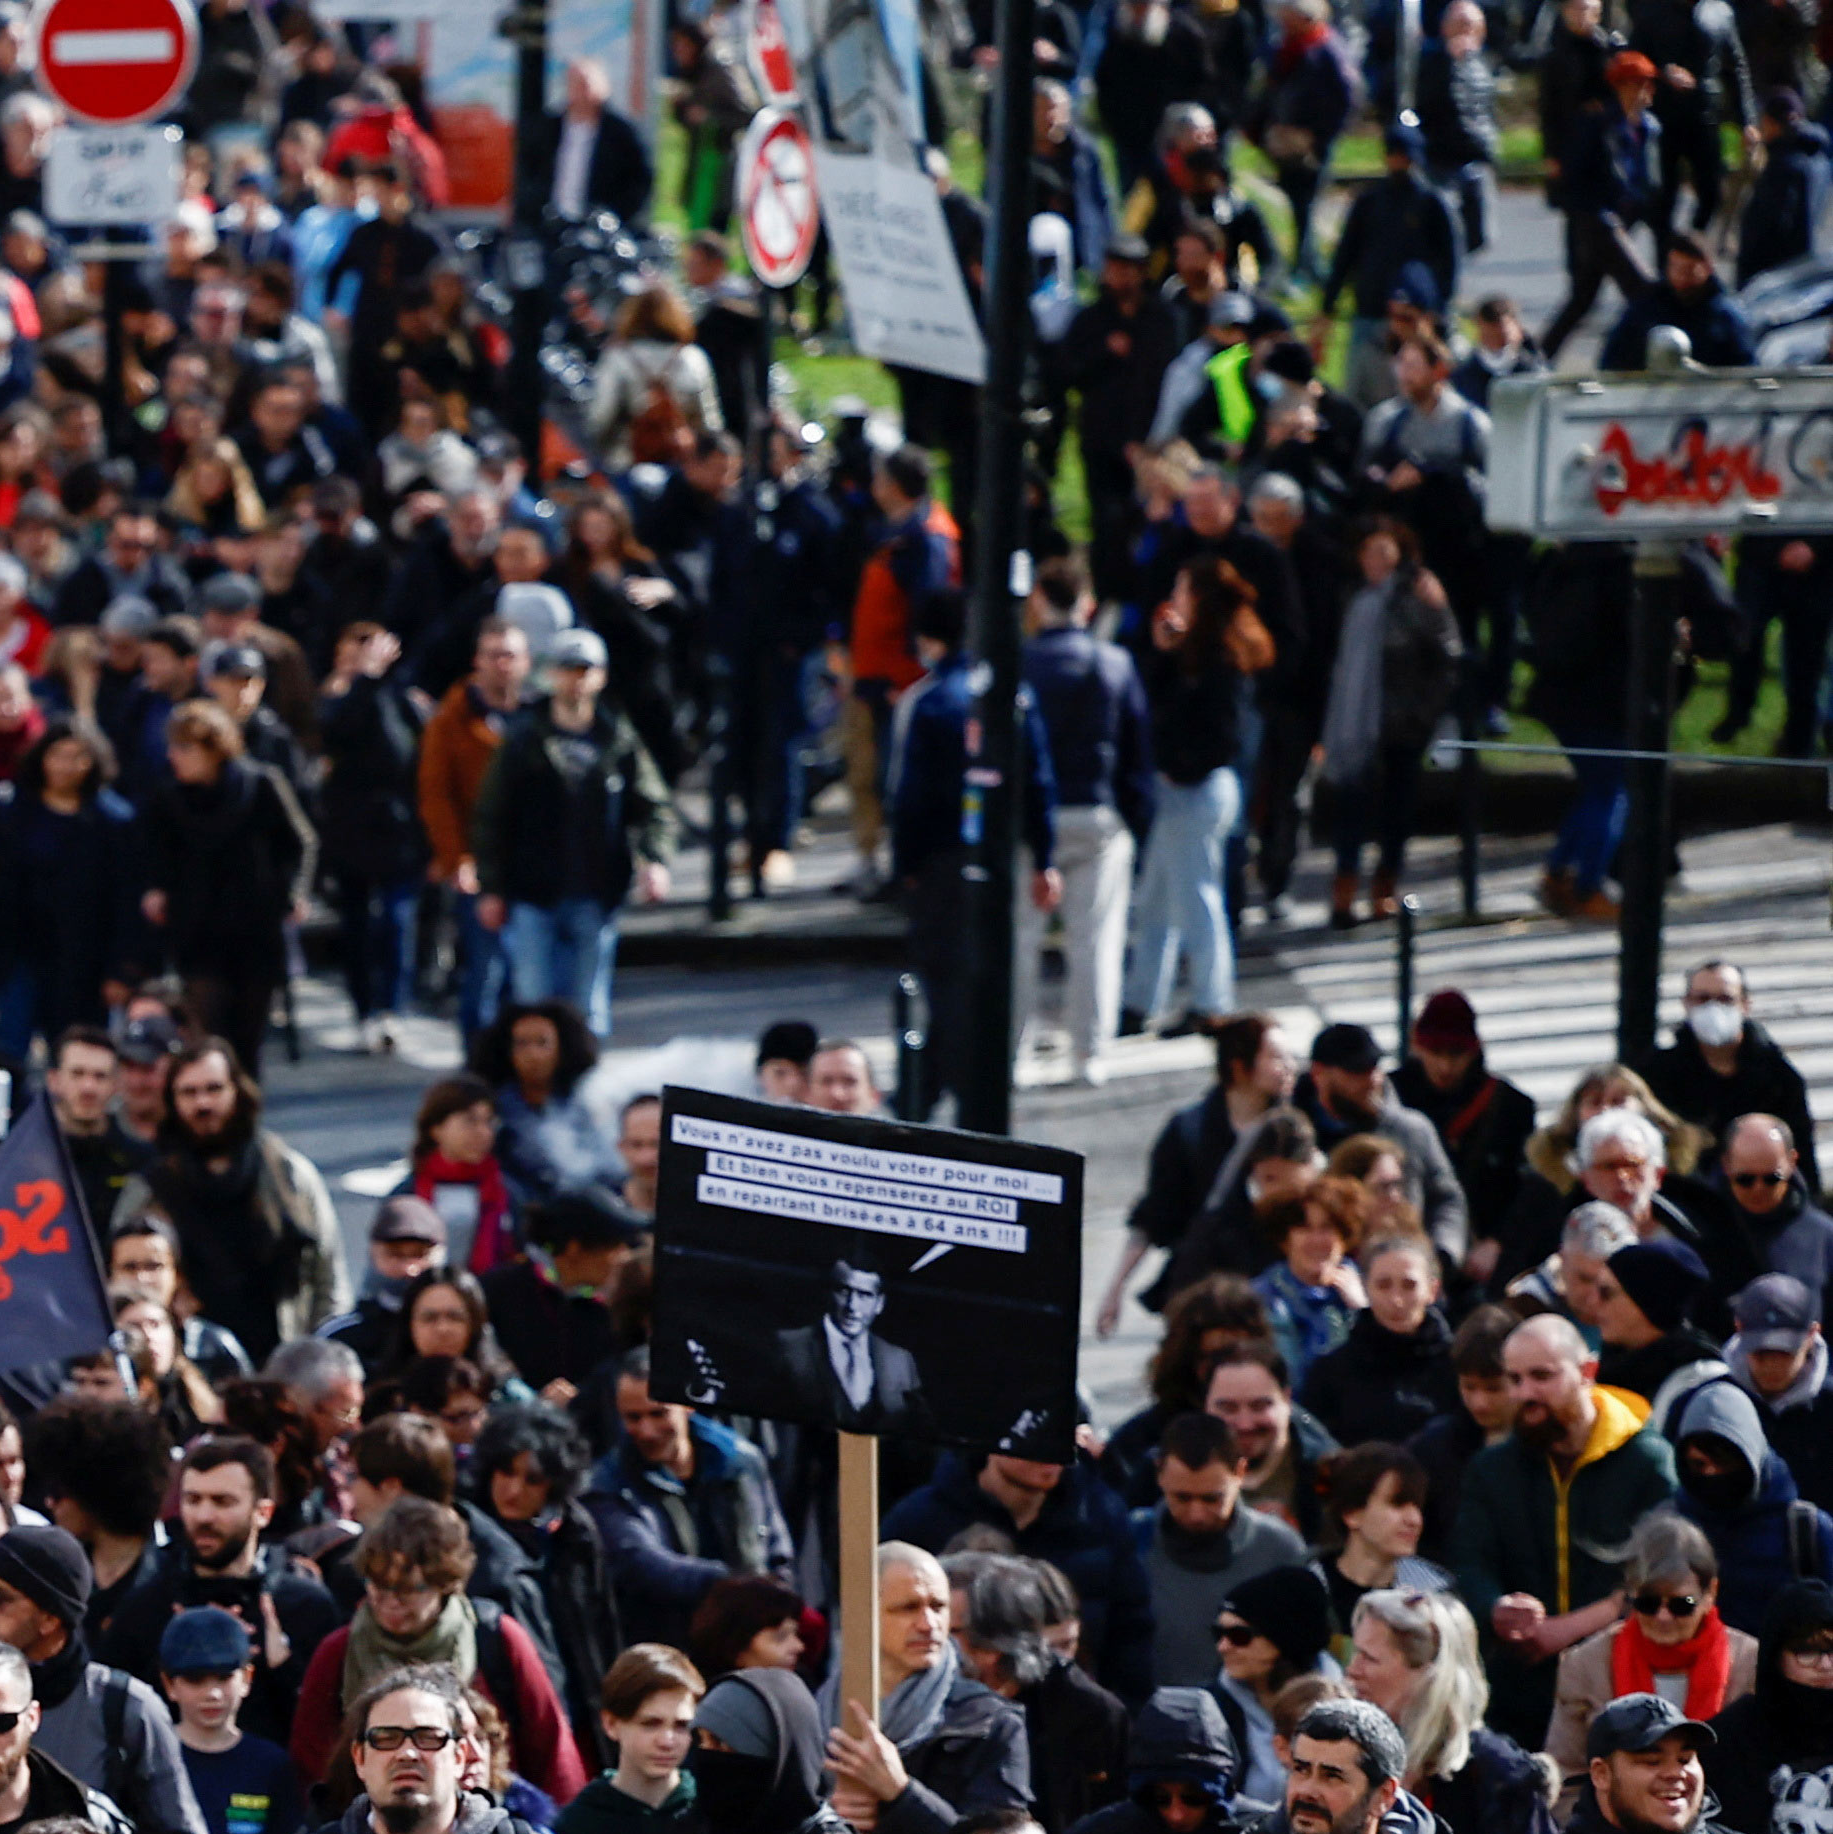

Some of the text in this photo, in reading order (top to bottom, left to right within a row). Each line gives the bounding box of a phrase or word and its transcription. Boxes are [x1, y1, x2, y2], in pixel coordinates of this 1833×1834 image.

[679, 1121, 721, 1142] Vous
[727, 1132, 784, 1153] n'avez
[791, 1143, 823, 1161] pas
[830, 1152, 880, 1170] voulu
[888, 1160, 936, 1177] voter
[944, 1167, 988, 1184] pour
[994, 1175, 1029, 1190] moi
[706, 1185, 727, 1199] en
[733, 1189, 816, 1214] repartant
[907, 1216, 917, 1229] à
[924, 1218, 946, 1232] 64
[954, 1227, 989, 1240] ans
[716, 1156, 1010, 1216] Et bien vous repenserez au ROI
